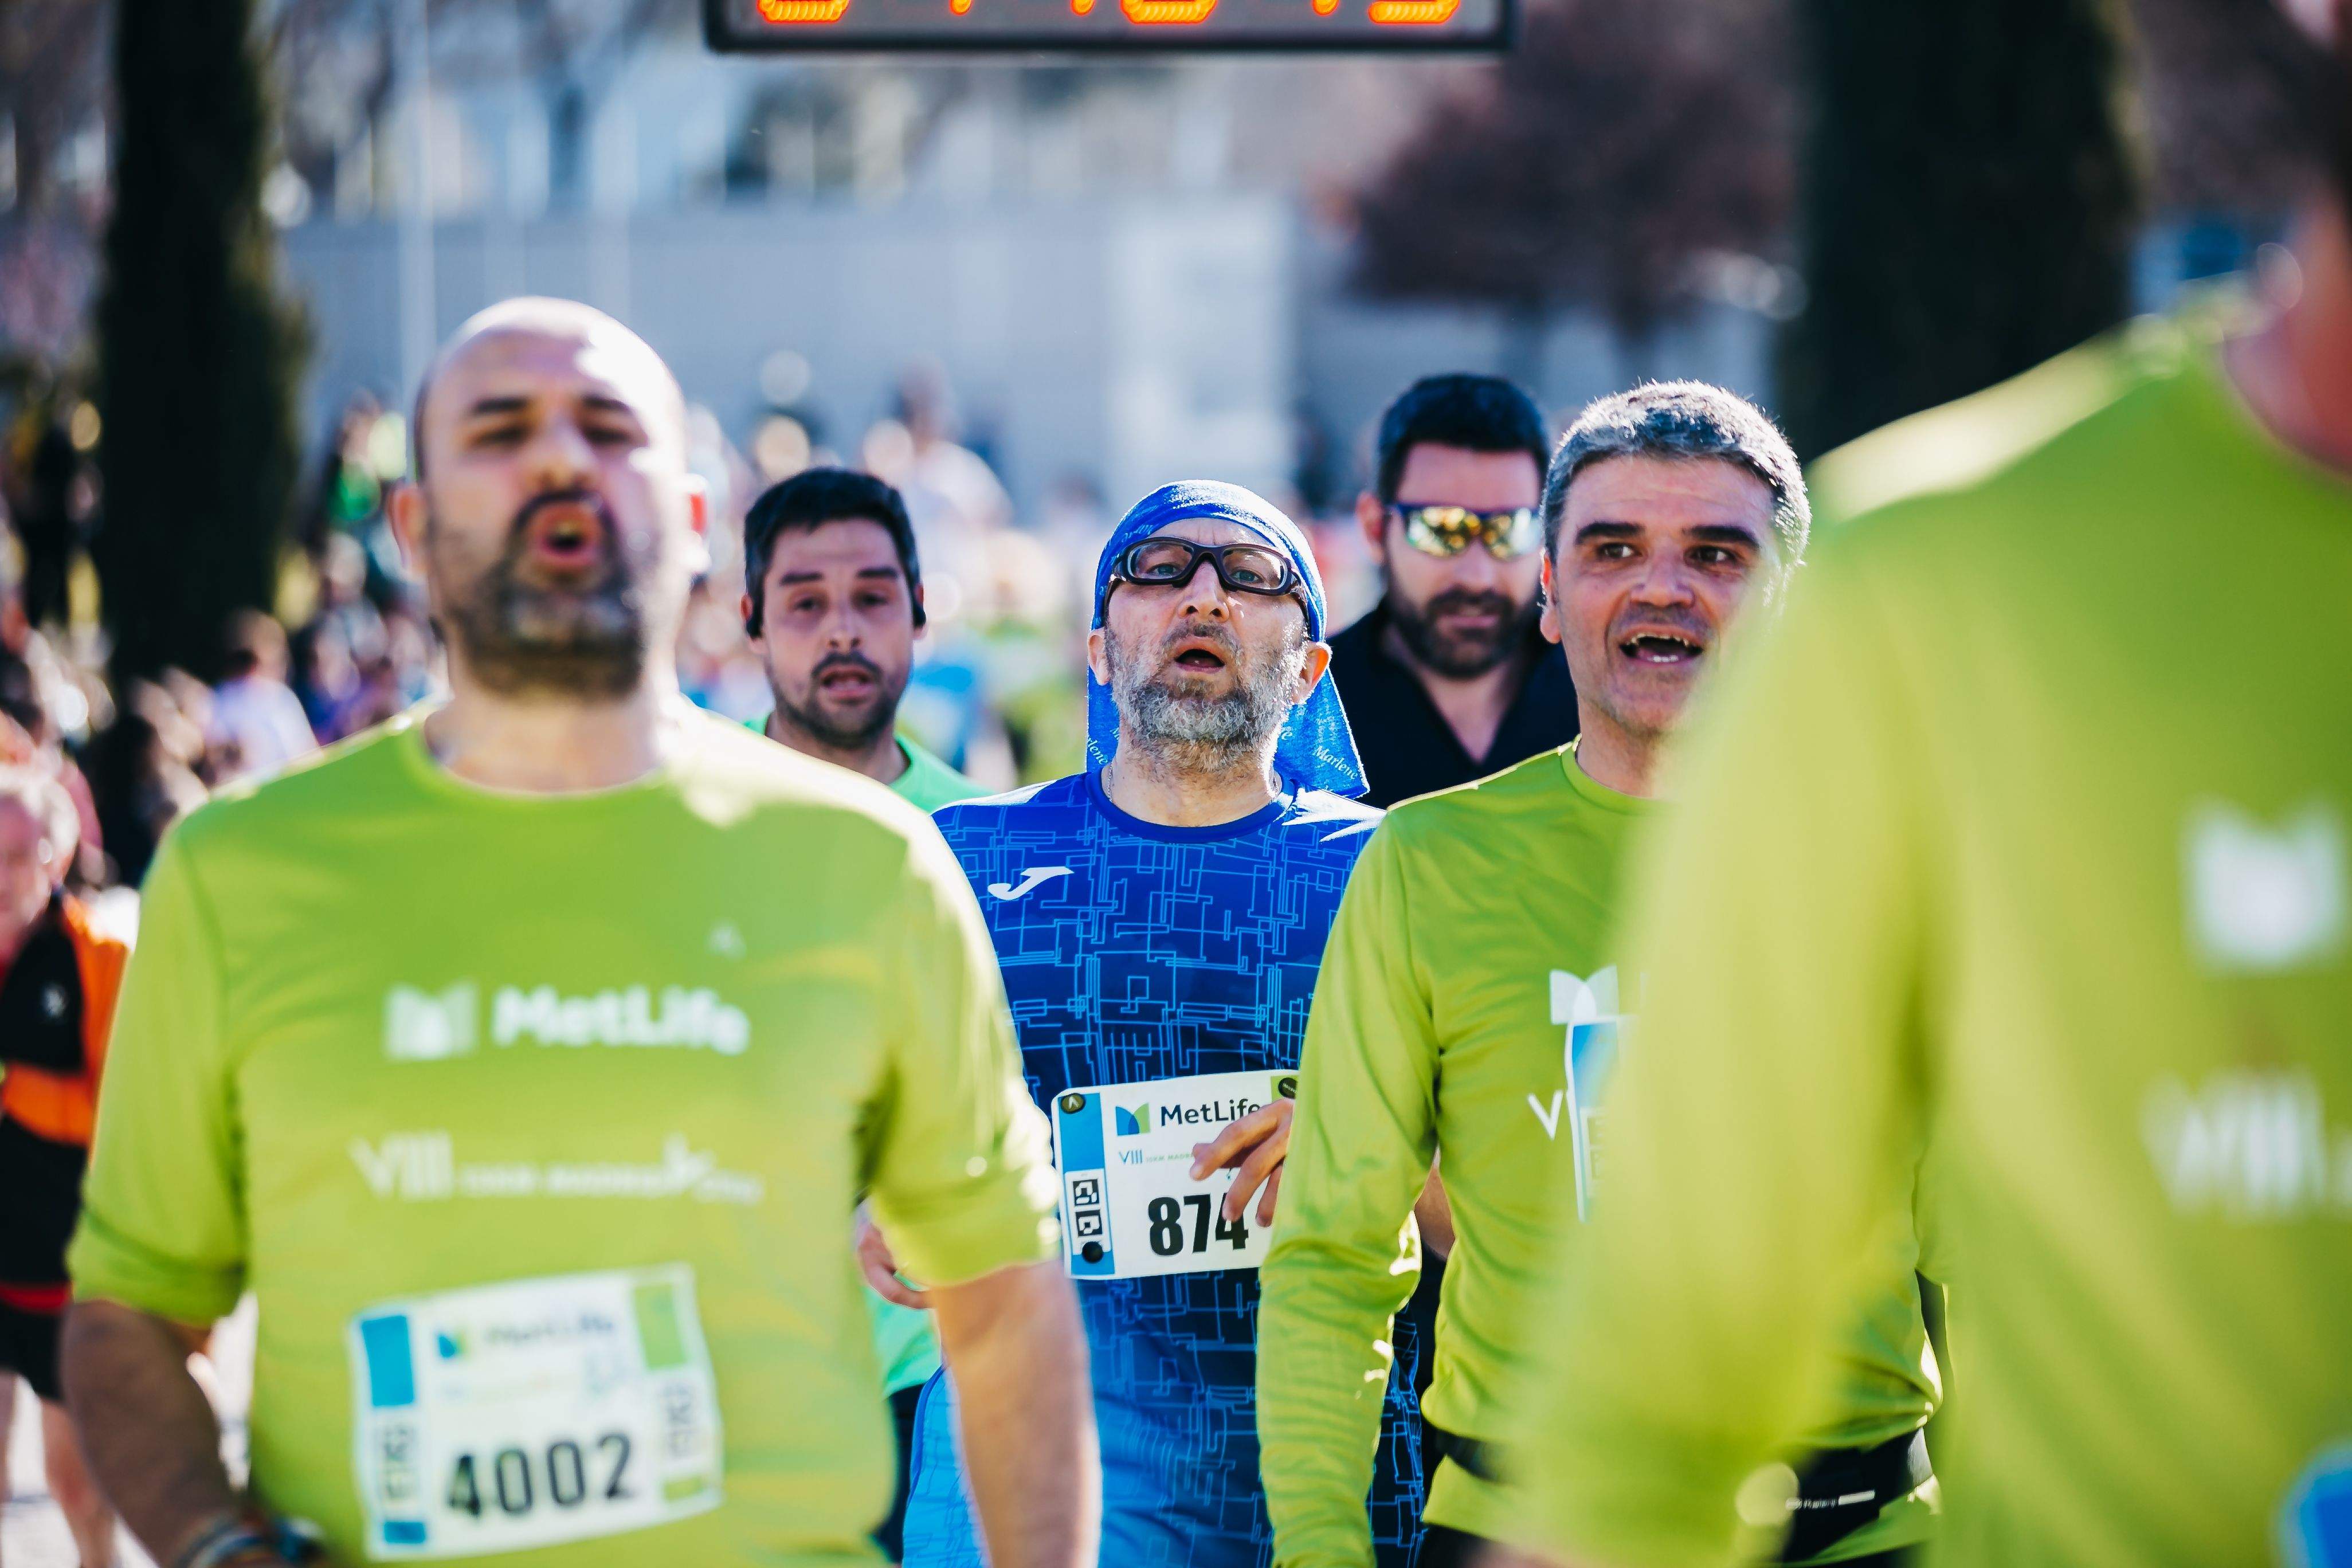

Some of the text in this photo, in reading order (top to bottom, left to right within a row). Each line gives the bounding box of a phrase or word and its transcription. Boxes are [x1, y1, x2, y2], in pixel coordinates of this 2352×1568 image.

[1312, 746, 1364, 779] Marlene
[1119, 1149, 1143, 1165] VIII
[1148, 1193, 1249, 1256] 874
[447, 1432, 635, 1519] 4002
